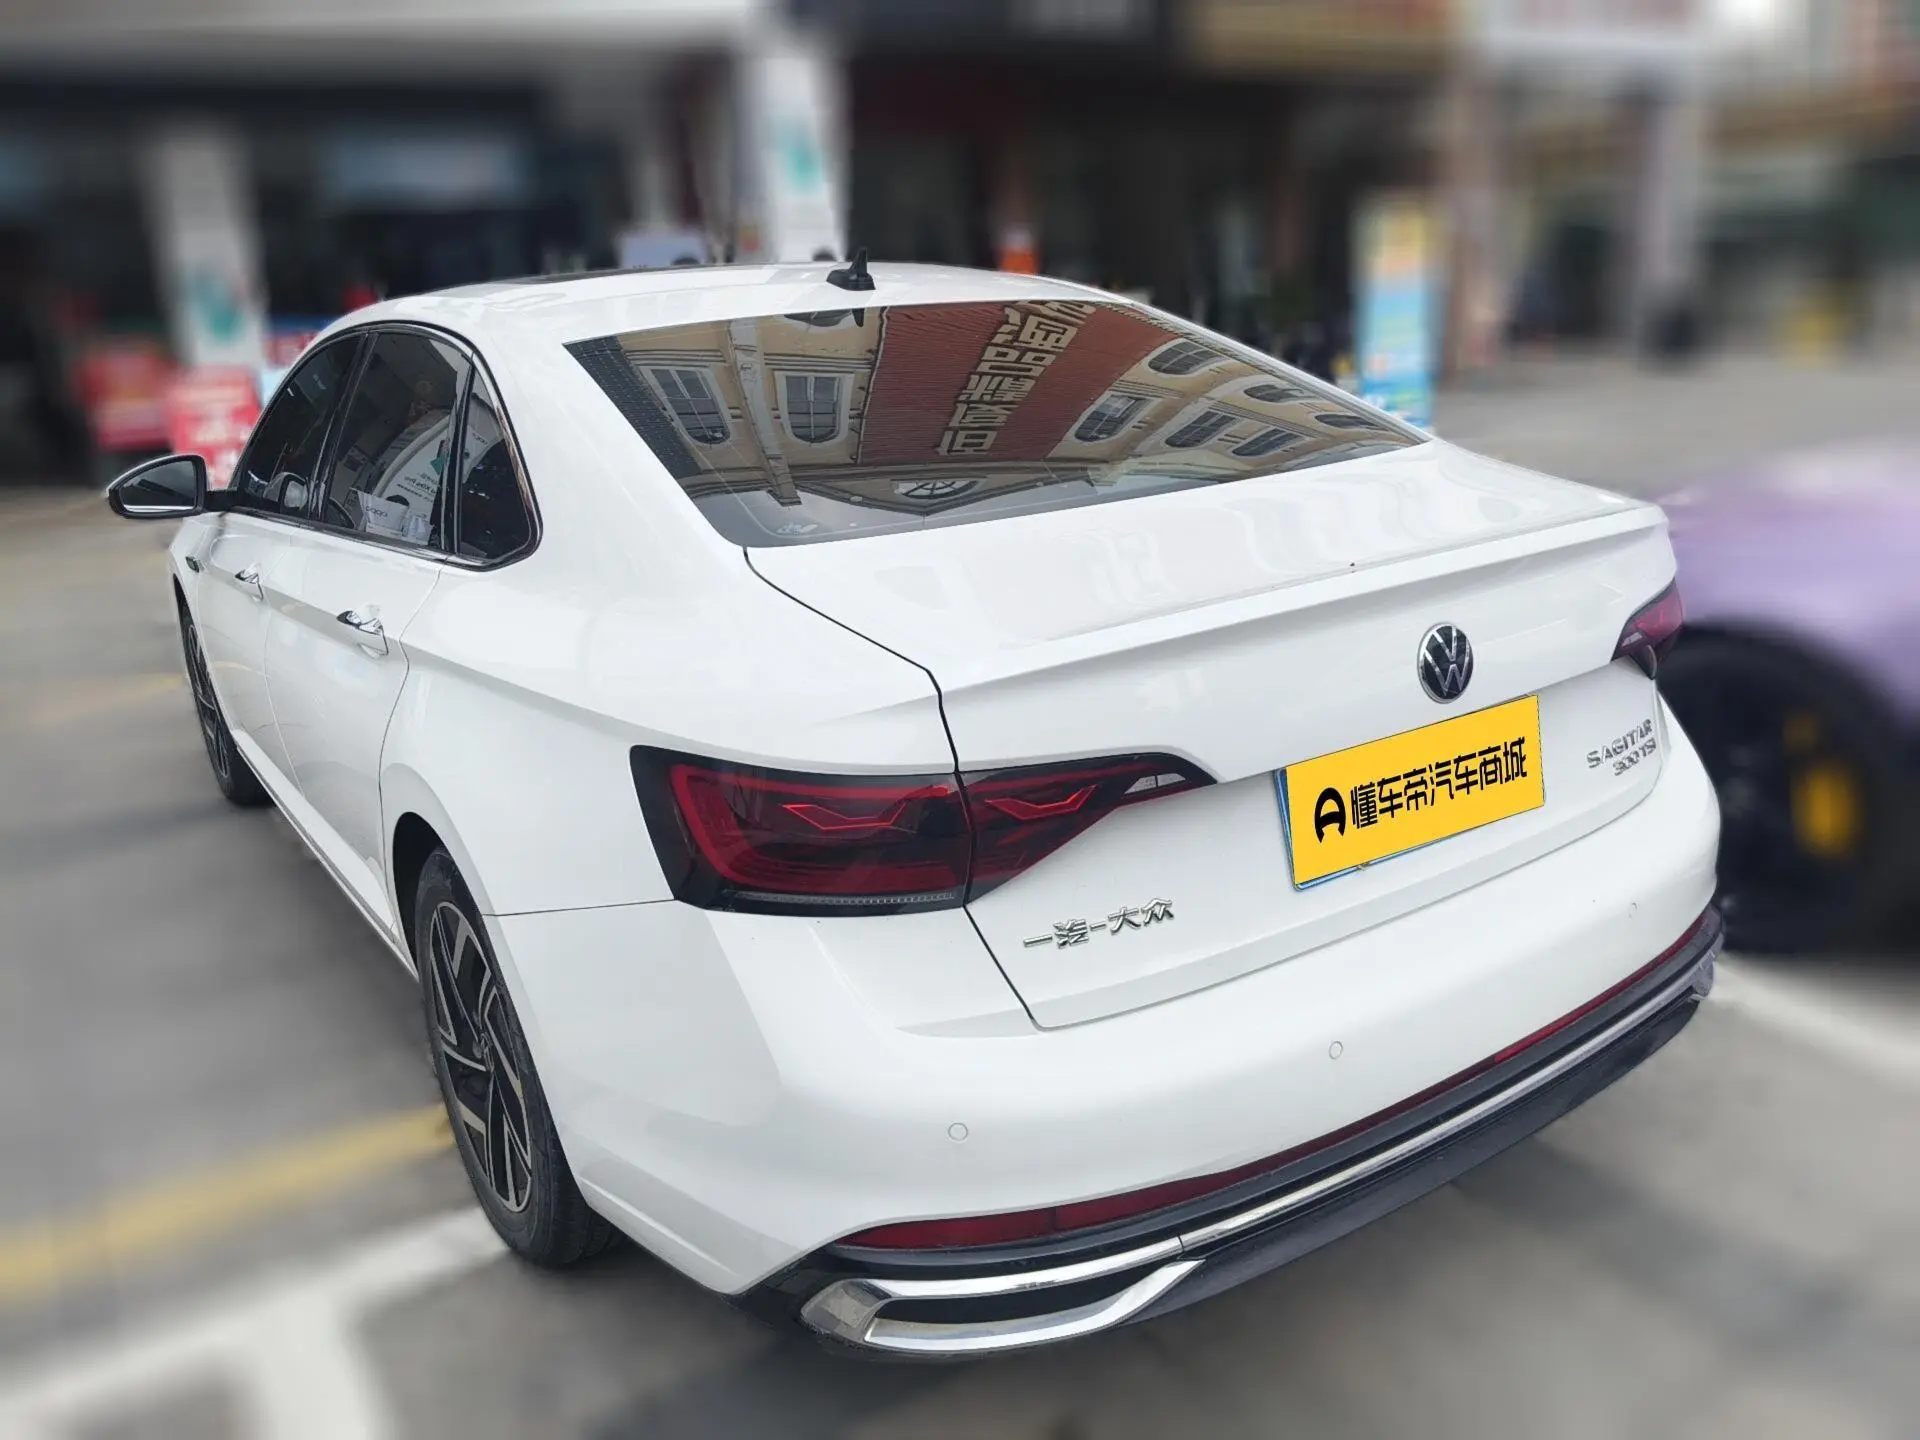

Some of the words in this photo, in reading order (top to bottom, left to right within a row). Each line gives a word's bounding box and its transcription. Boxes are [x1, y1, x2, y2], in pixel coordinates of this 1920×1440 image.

[1586, 718, 1653, 769] SAGITAR
[1023, 897, 1176, 949] 一汽-大众
